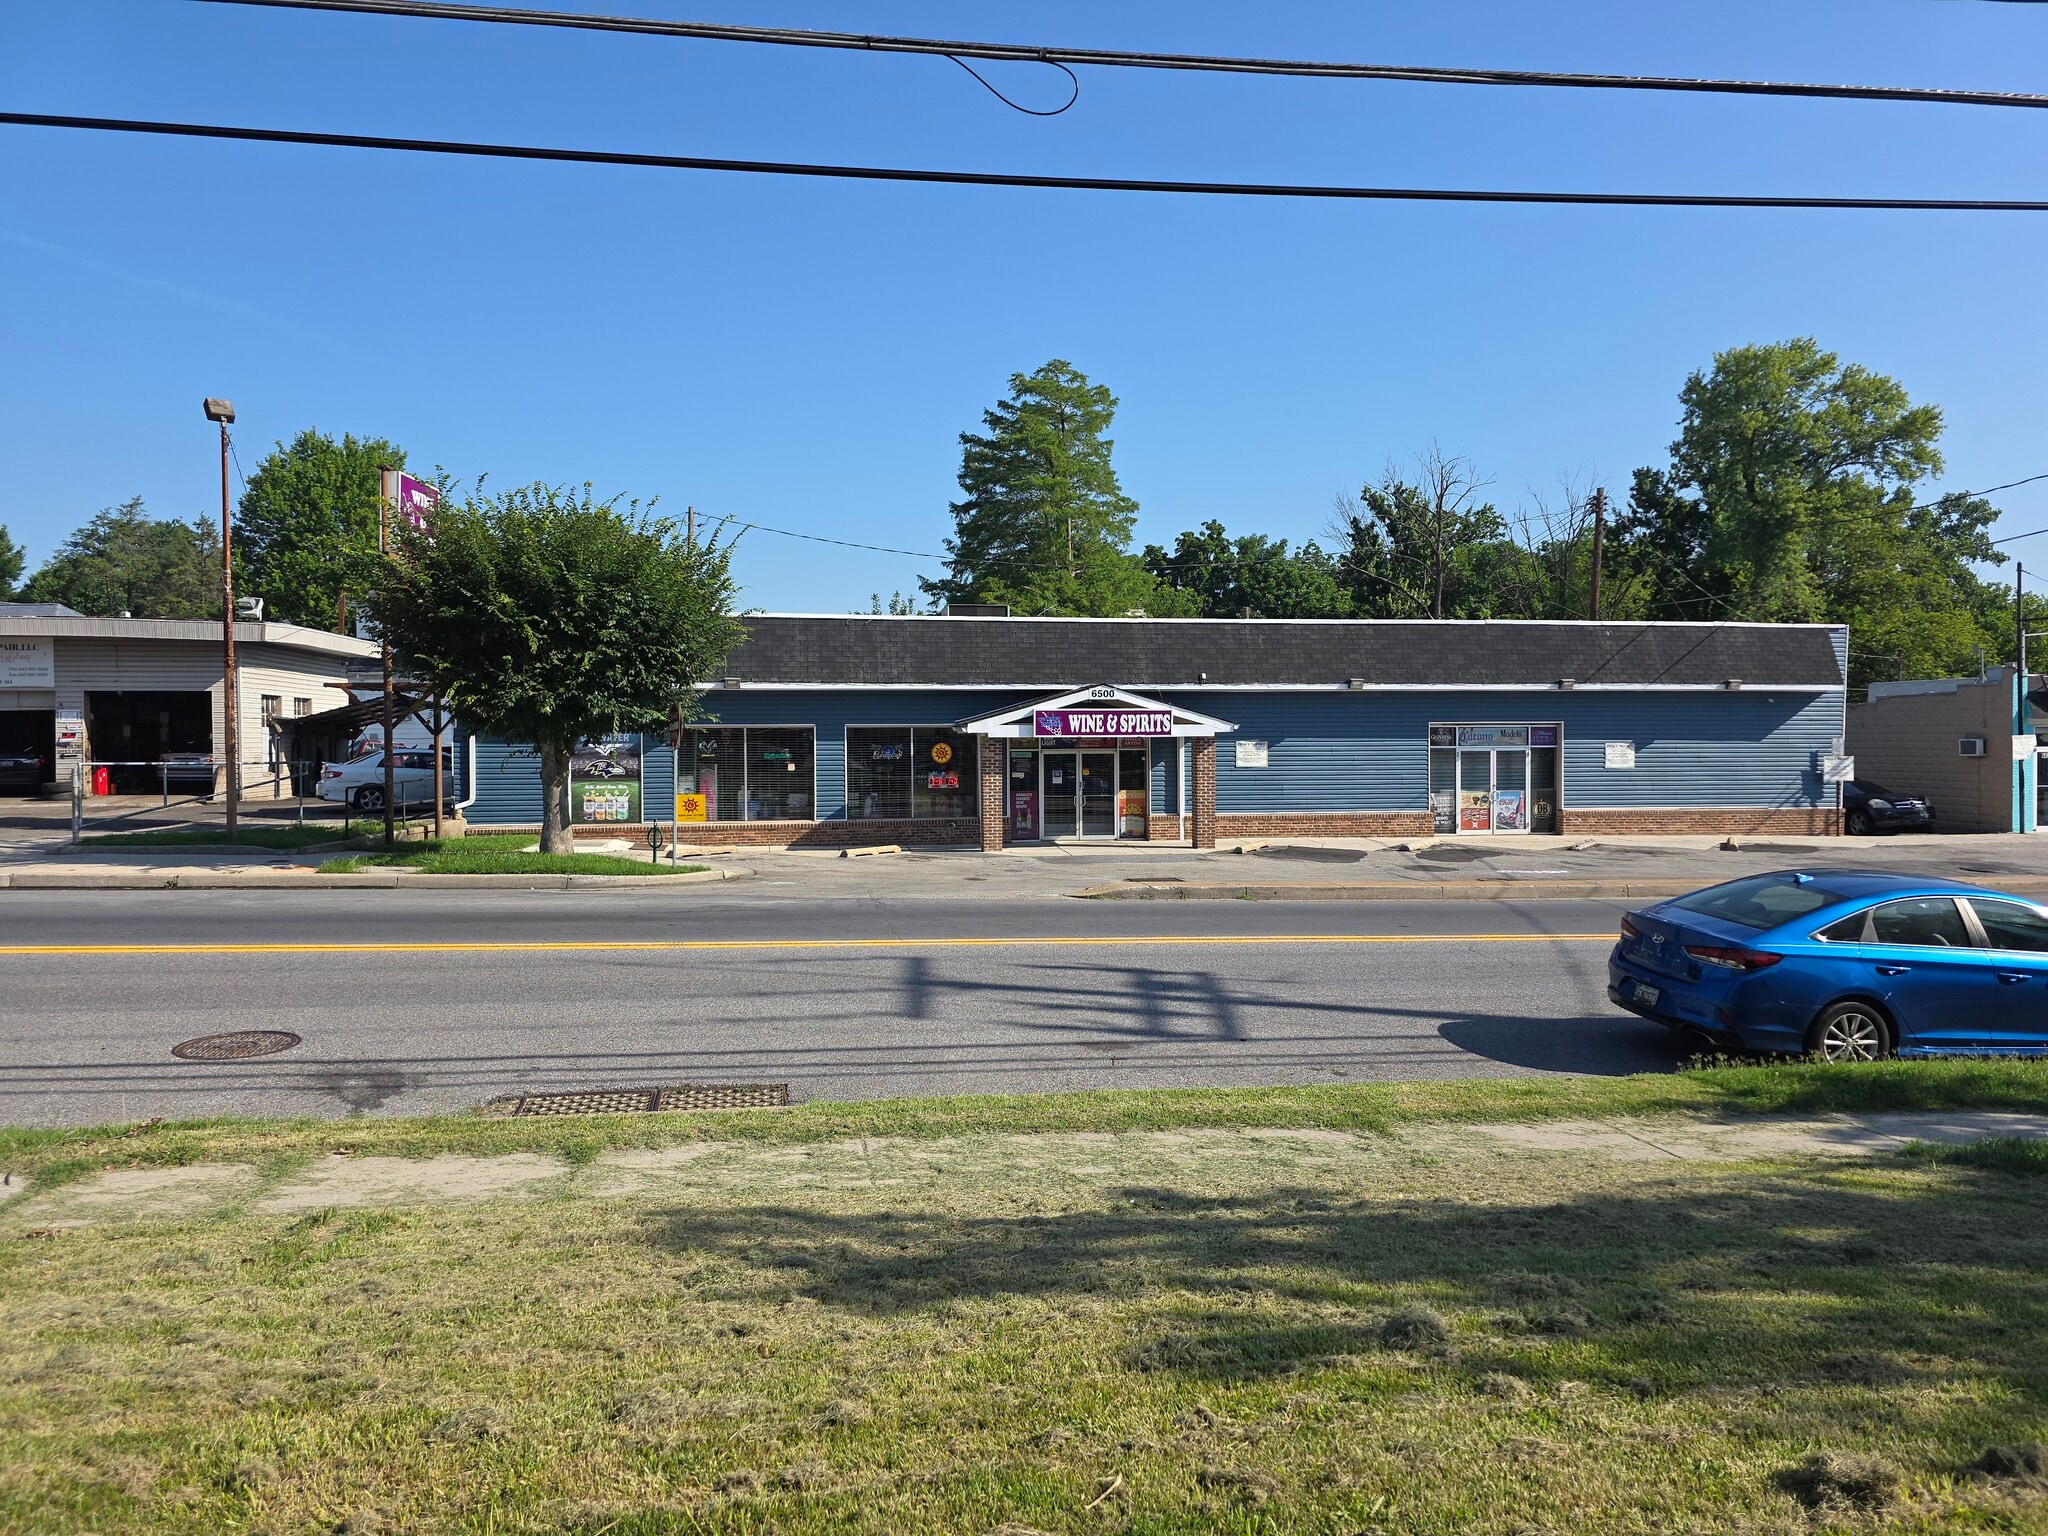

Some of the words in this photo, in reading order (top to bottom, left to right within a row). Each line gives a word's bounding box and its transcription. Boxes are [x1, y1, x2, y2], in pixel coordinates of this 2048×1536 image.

[1091, 689, 1115, 698] 6500
[1068, 713, 1105, 733] WINE
[1106, 713, 1117, 733] &
[1119, 713, 1171, 733] SPIRITS
[1461, 731, 1493, 742] Corona
[1500, 729, 1522, 738] Modelo
